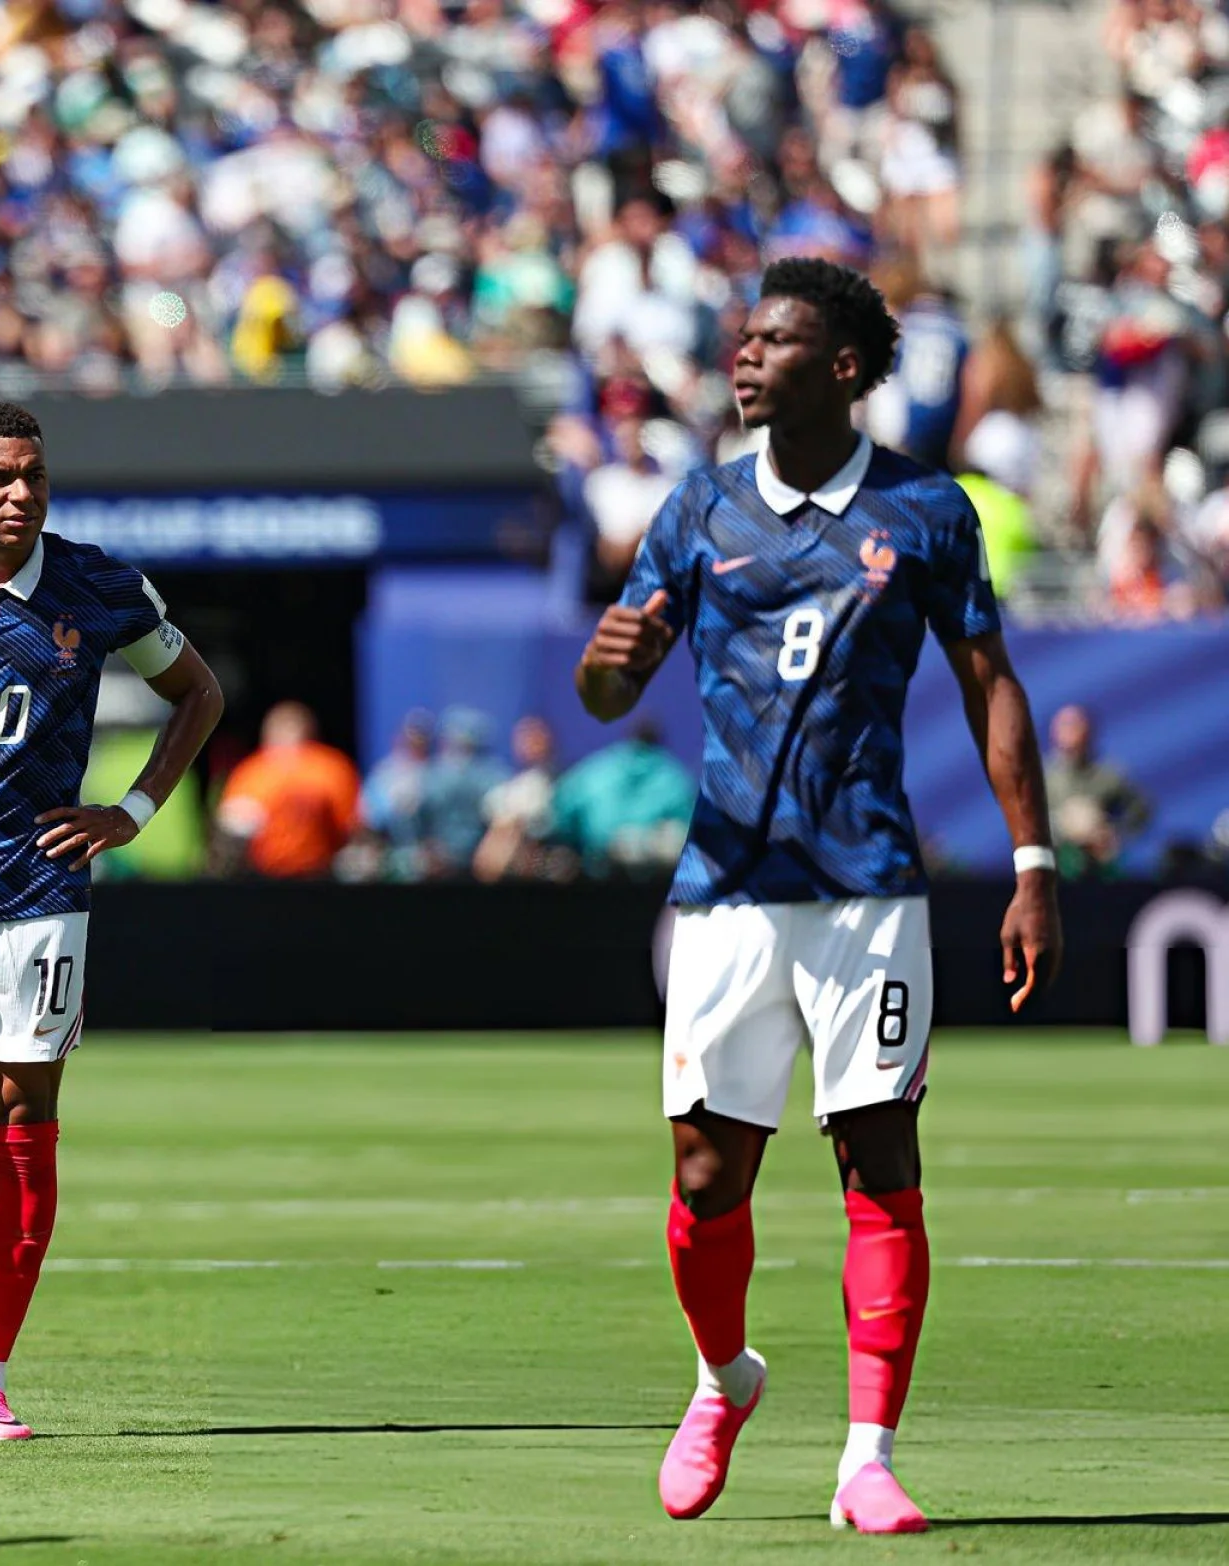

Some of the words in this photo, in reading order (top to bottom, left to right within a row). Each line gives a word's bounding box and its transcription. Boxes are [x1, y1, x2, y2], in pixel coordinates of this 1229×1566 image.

[776, 608, 826, 681] 8
[33, 955, 73, 1016] 10
[877, 980, 910, 1047] 8
